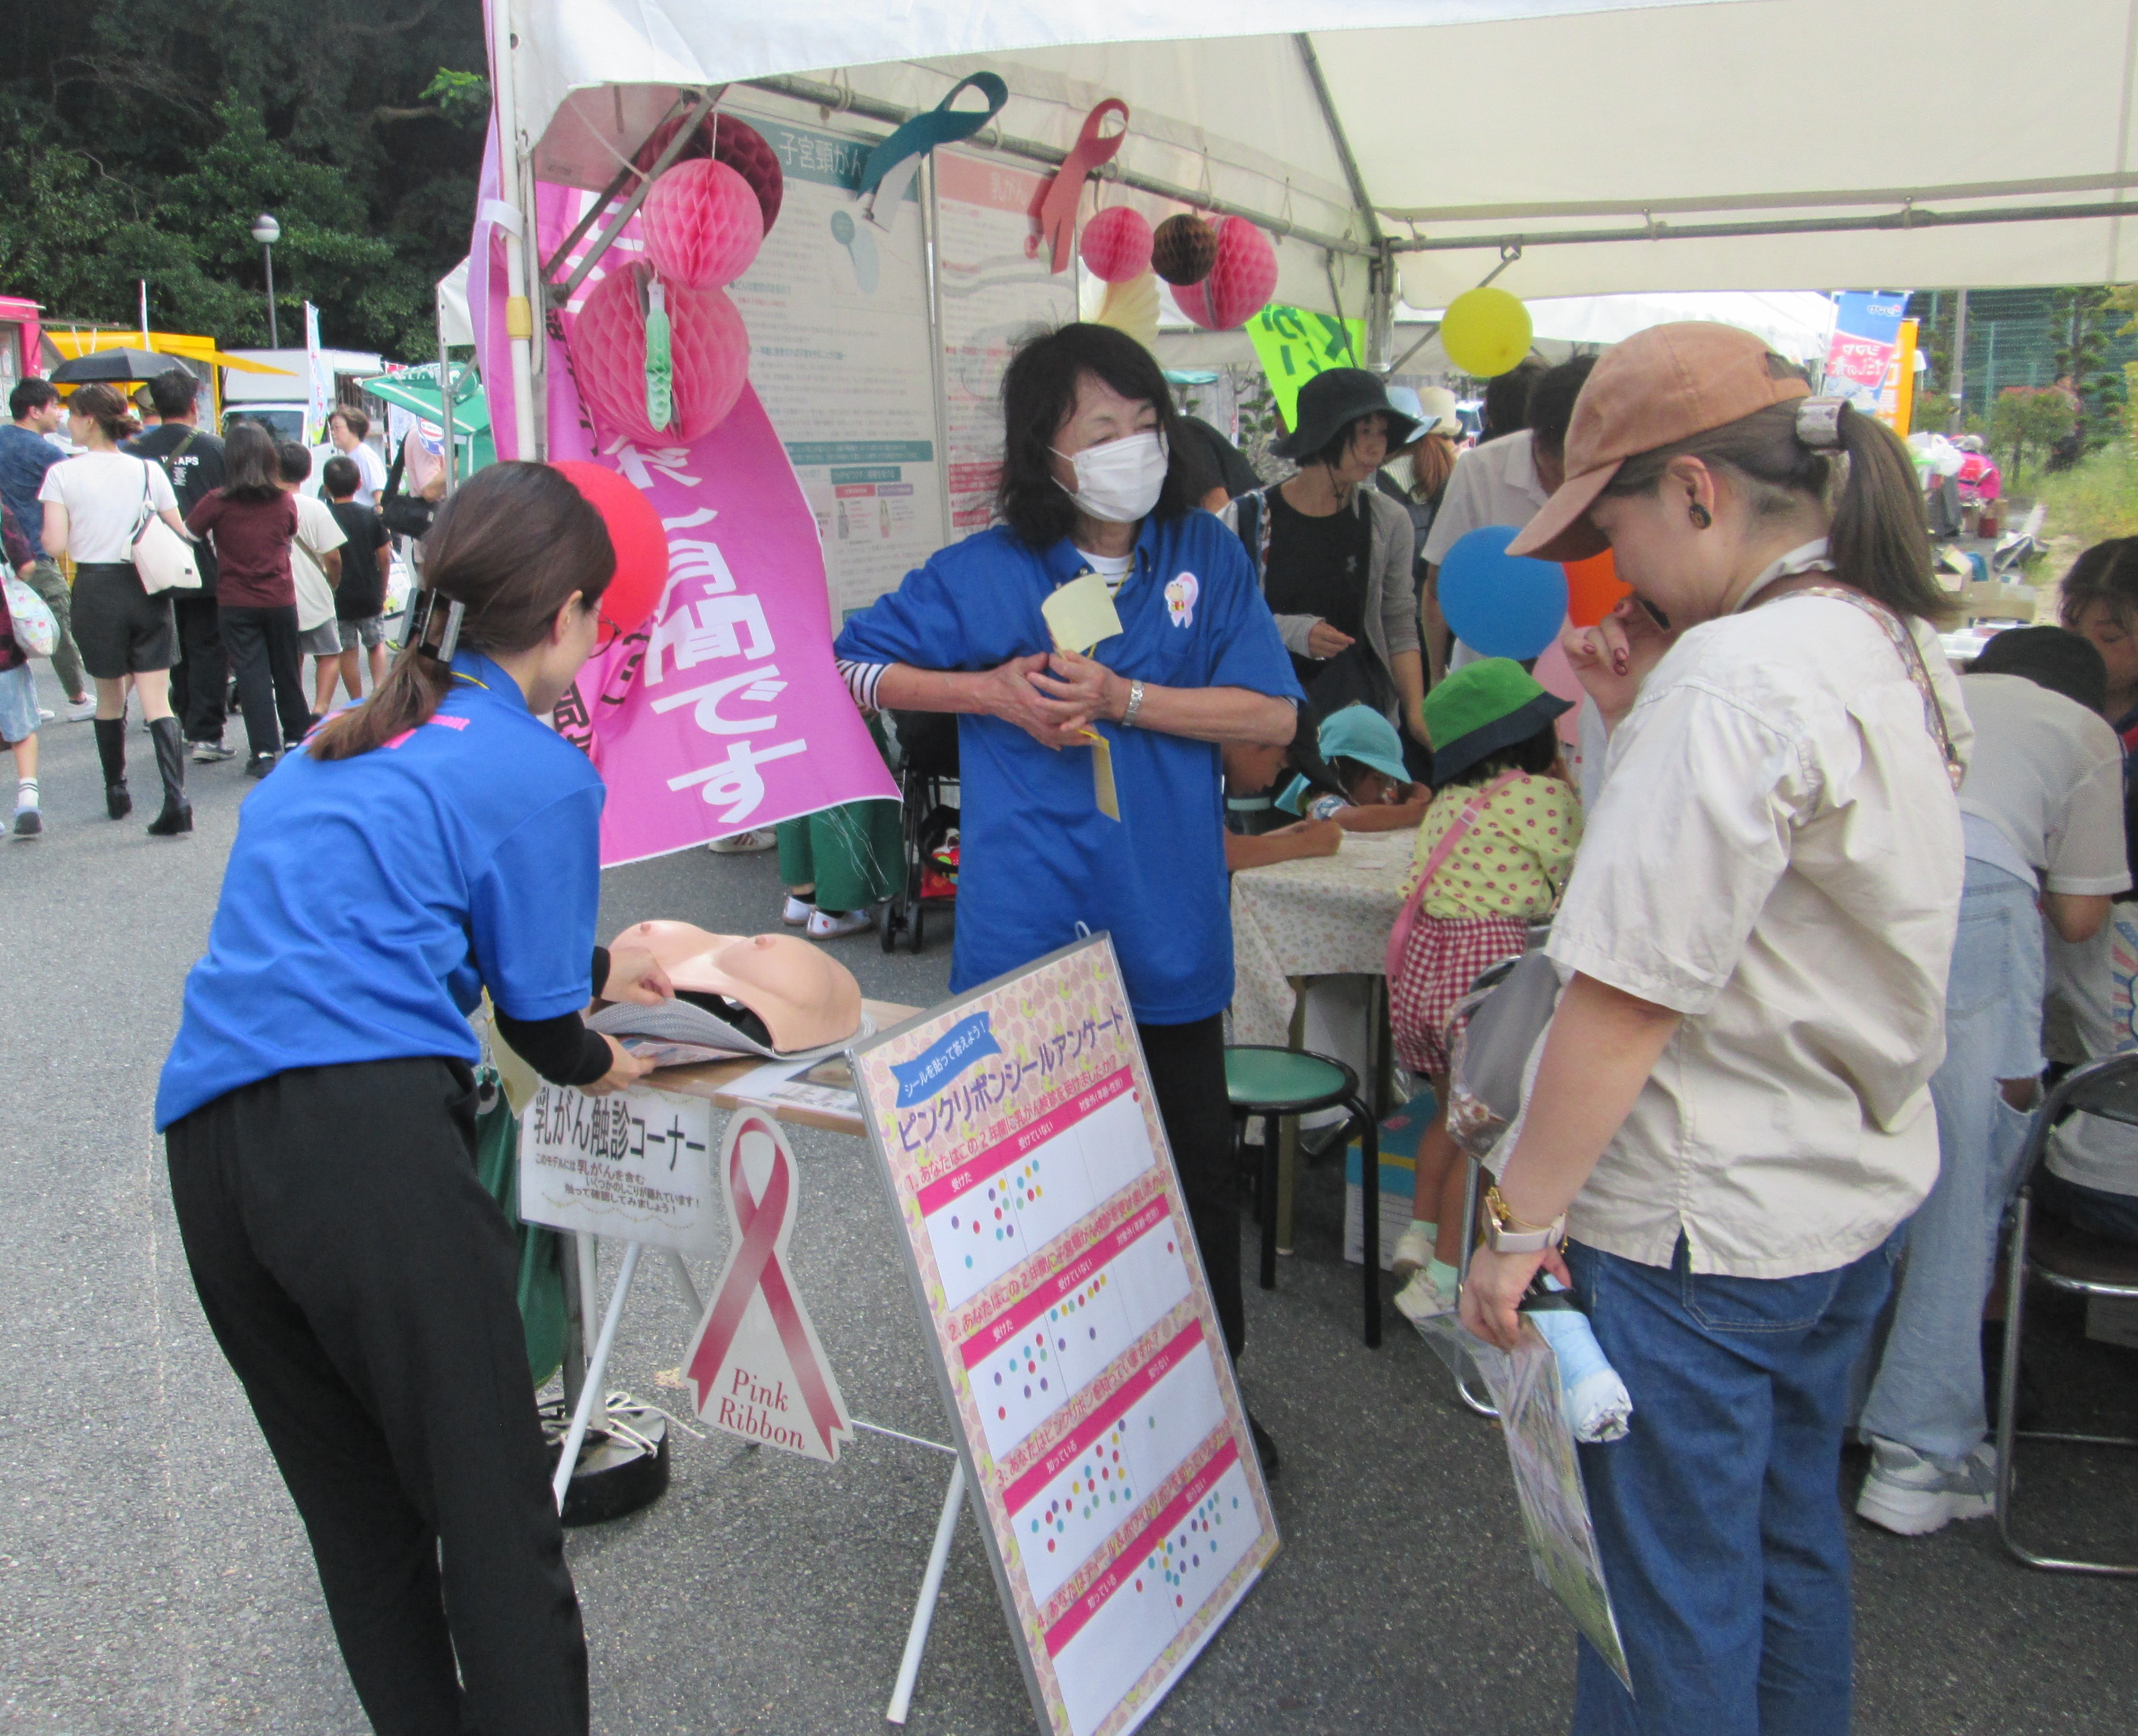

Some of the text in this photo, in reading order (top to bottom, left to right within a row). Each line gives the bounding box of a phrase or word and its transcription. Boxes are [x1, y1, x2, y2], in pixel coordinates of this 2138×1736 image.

[898, 1005, 1123, 1152] ピンクリボンシールアンケート
[904, 1019, 986, 1098] シールを貼って答えよう！
[533, 1086, 706, 1172] 乳がん触診コーナー
[951, 1171, 973, 1194] 受けた
[1018, 1120, 1054, 1152] 受けていない
[993, 1319, 1014, 1343] 受けた
[1058, 1257, 1093, 1293] 受けていない
[717, 1396, 806, 1450] Ribbon
[731, 1367, 788, 1412] Pink
[1046, 1439, 1078, 1475] 知っている
